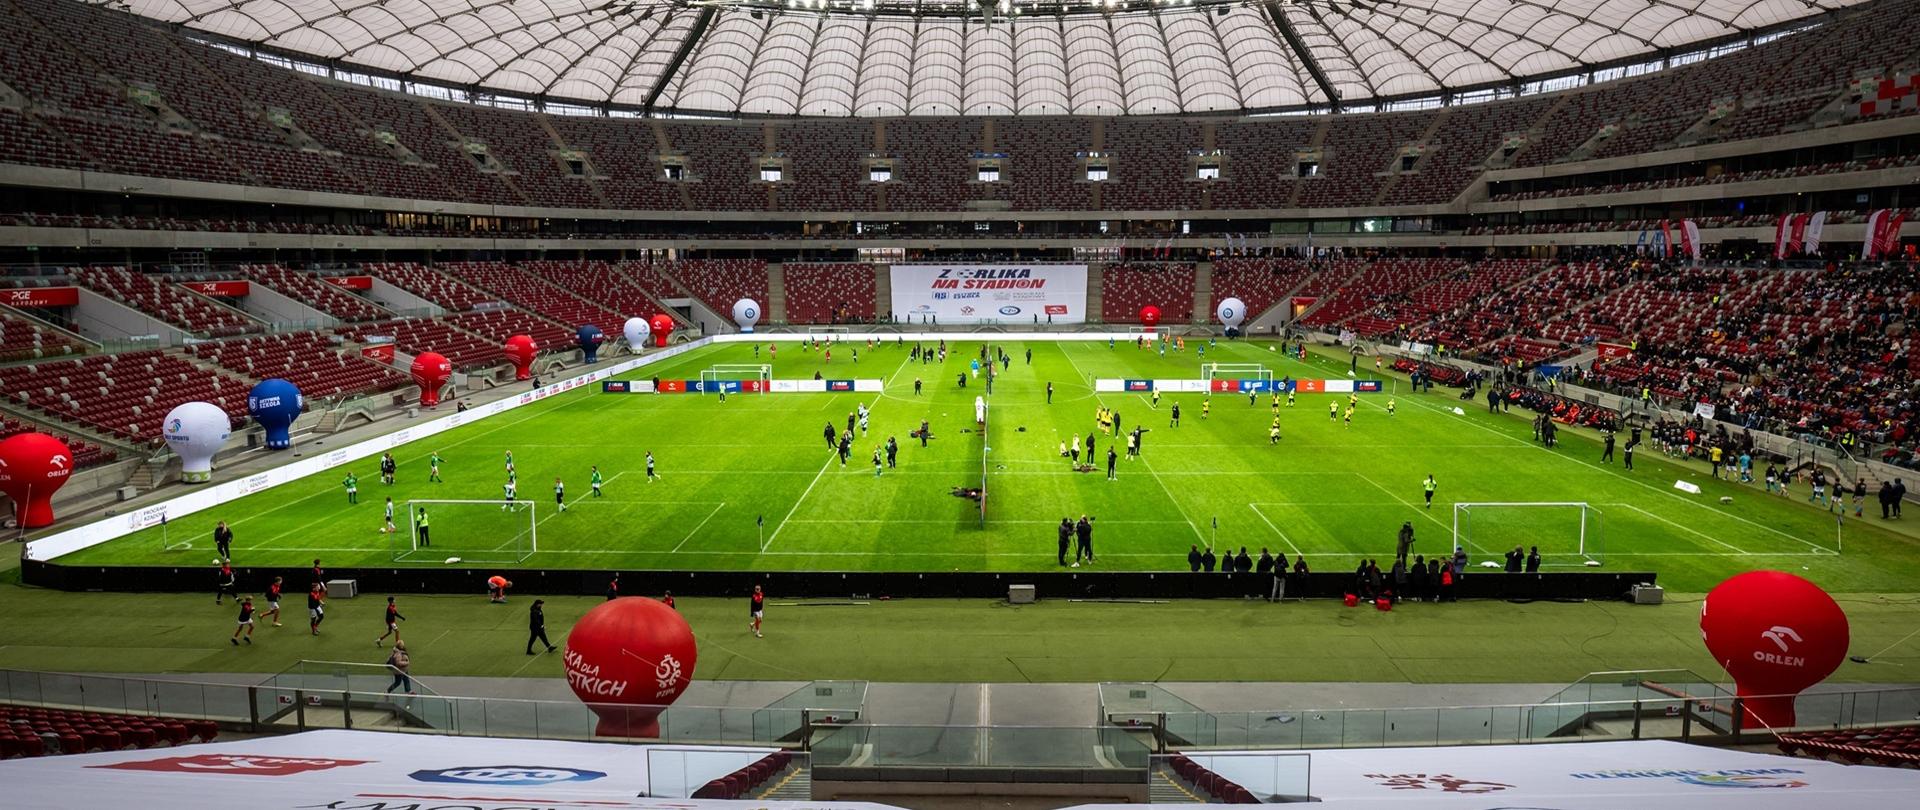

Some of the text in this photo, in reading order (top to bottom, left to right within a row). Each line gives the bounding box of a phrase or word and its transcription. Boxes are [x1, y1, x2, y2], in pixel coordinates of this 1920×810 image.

[931, 279, 1046, 289] NA STADION
[11, 290, 31, 300] PGE
[47, 468, 70, 478] ORLEN
[1753, 651, 1805, 667] ORLEN
[581, 664, 600, 676] DLA
[566, 669, 627, 697] STKICH
